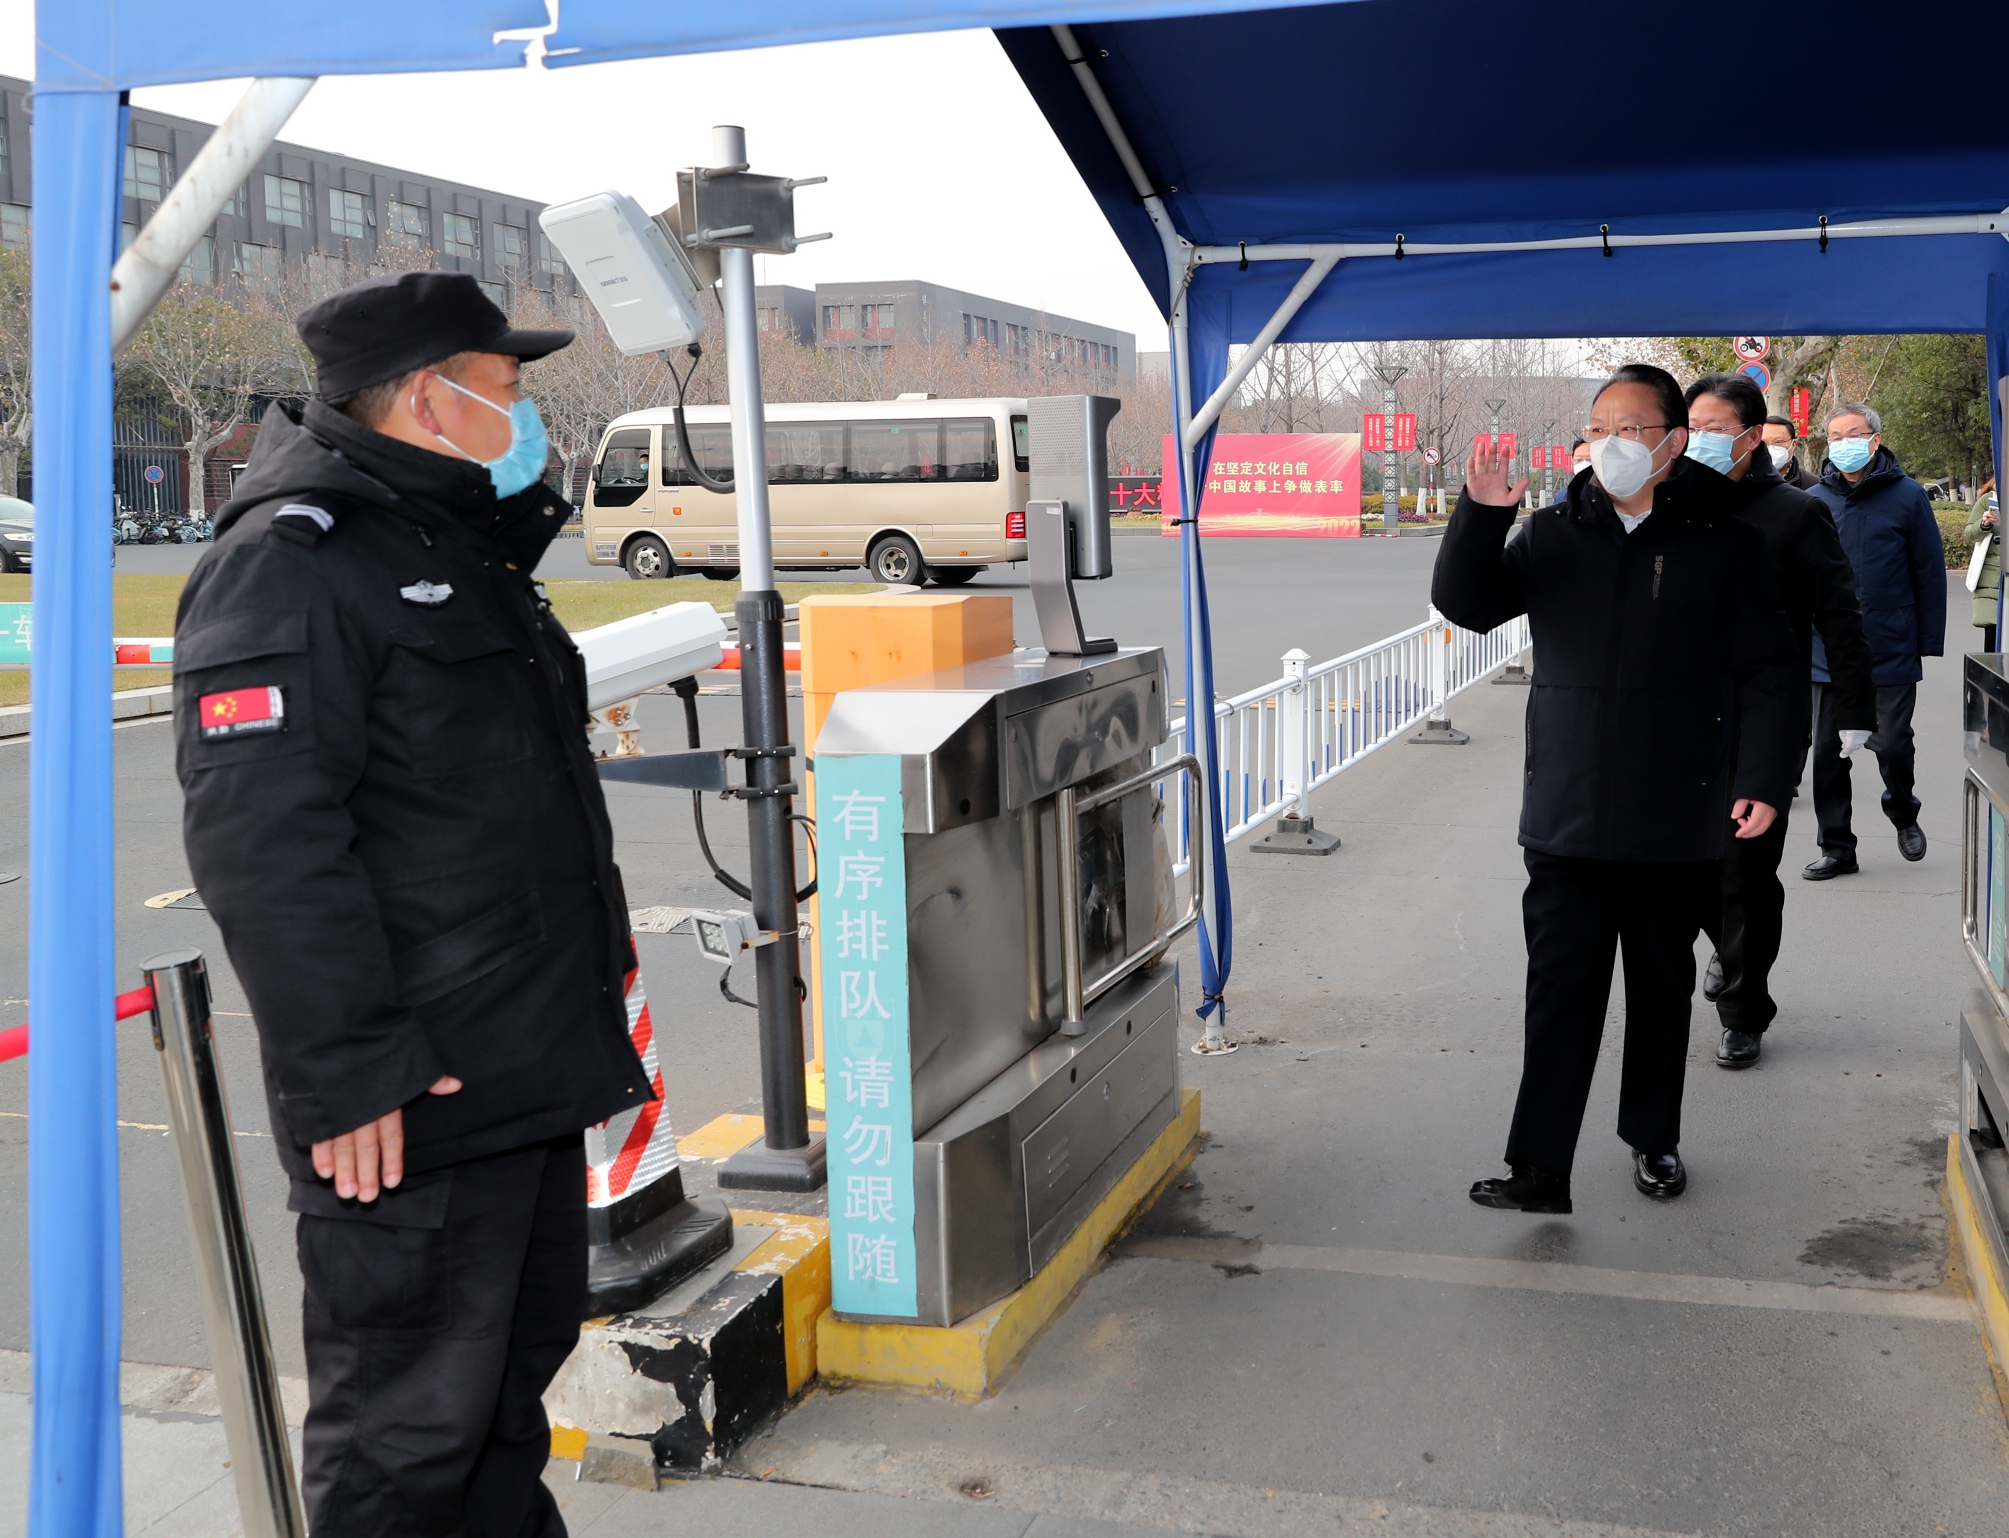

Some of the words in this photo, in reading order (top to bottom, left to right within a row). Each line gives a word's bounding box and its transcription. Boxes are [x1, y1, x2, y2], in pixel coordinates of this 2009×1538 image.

[1212, 461, 1309, 476] 在坚定文化自信
[1109, 481, 1162, 506] 十大
[1204, 479, 1344, 494] 中国故事上争做表率
[234, 718, 279, 731] CHINESE
[832, 789, 892, 1021] 有序排队
[839, 1055, 900, 1285] 请勿跟随
